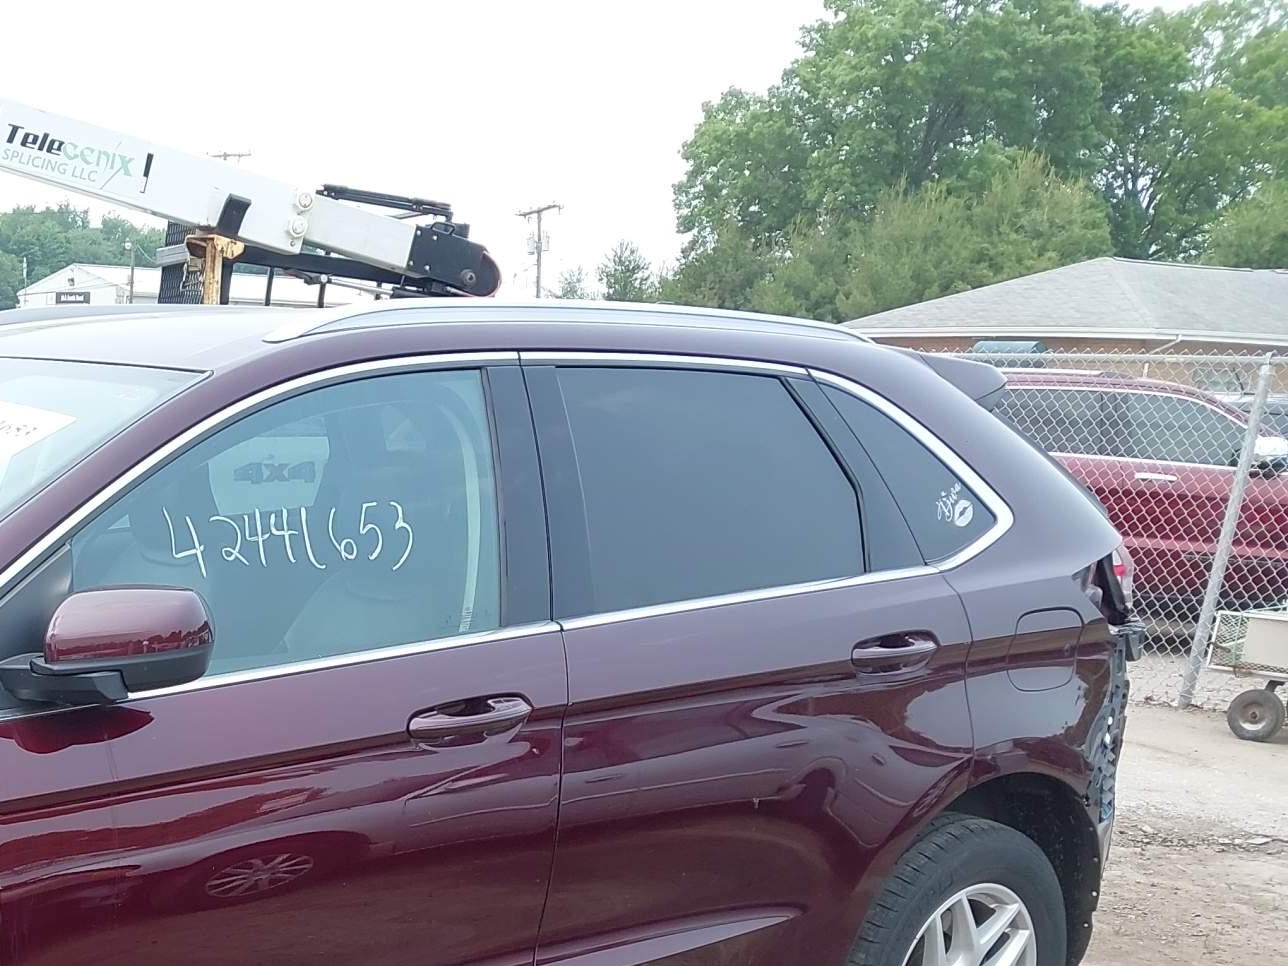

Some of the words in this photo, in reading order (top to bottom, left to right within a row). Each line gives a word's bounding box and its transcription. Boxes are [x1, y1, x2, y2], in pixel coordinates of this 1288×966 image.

[2, 148, 69, 175] SPLICING
[72, 166, 99, 182] LLC
[163, 501, 414, 579] 42441653
